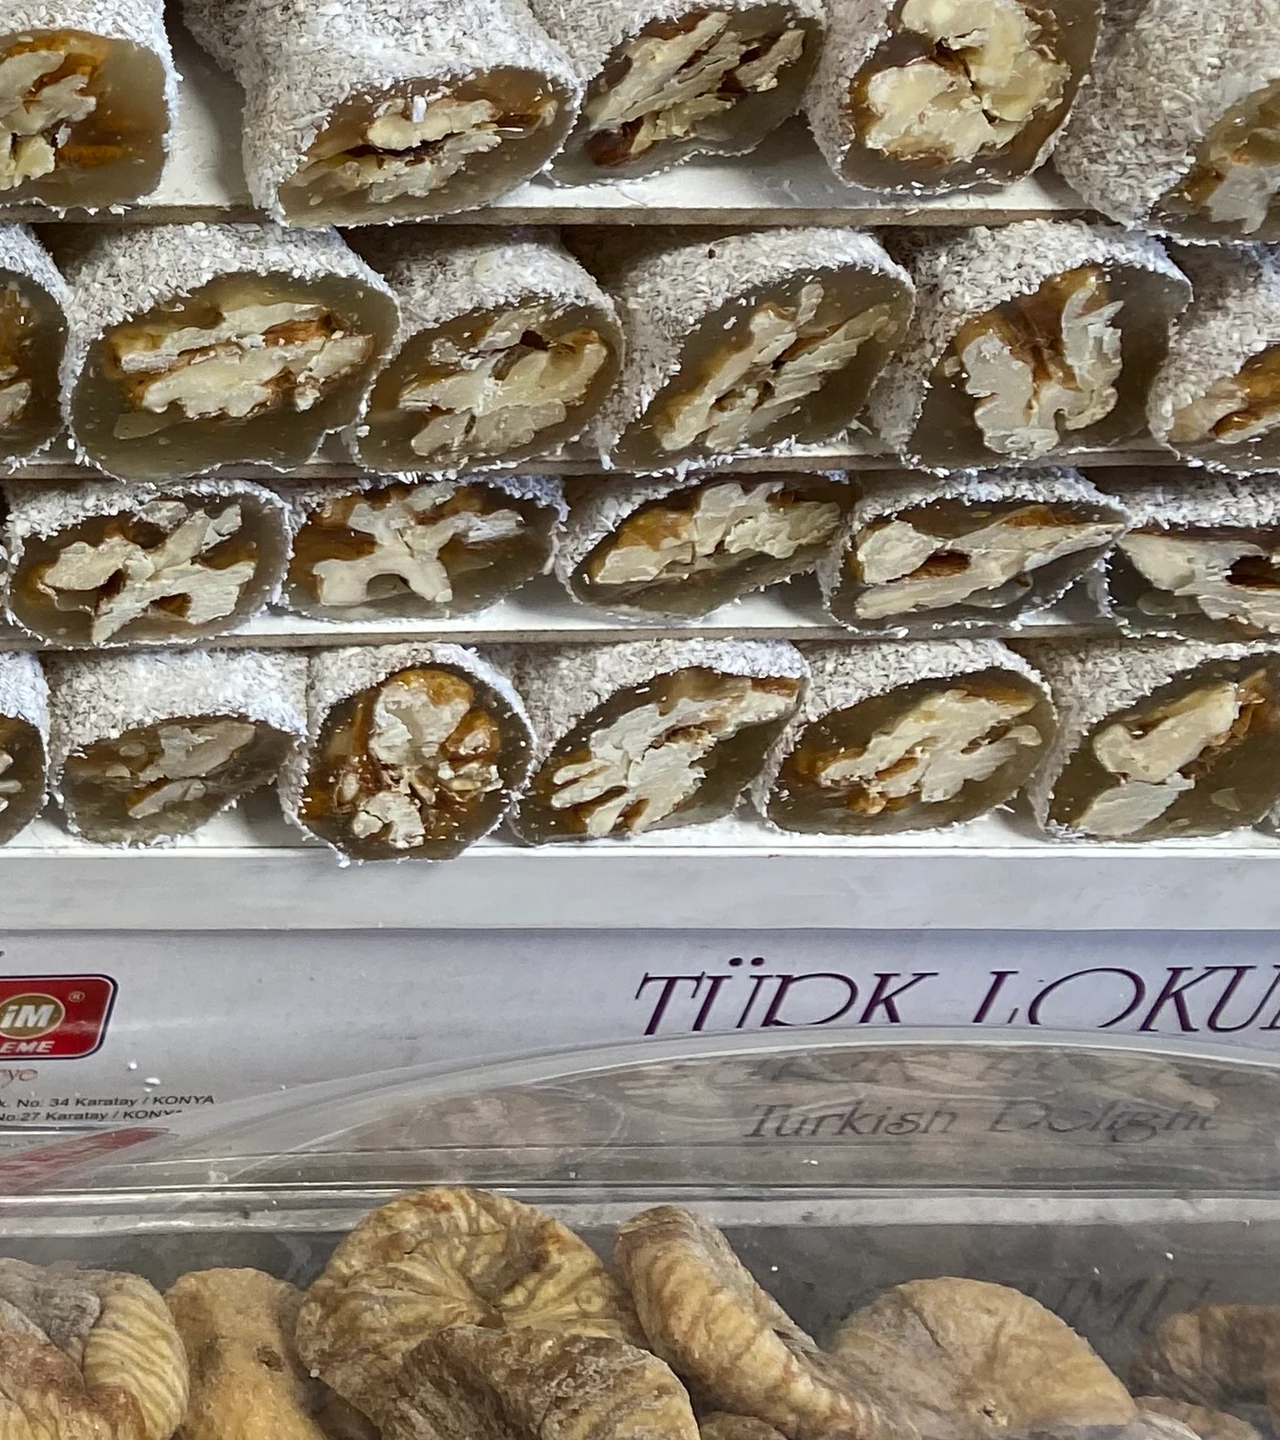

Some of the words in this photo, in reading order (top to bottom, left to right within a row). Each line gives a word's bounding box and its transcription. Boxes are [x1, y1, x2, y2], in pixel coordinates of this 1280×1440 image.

[972, 964, 1280, 1033] LOKU
[49, 1097, 70, 1107] 34
[75, 1096, 140, 1109] Karatay
[152, 1095, 215, 1105] KONYA
[45, 1110, 108, 1123] Karatay
